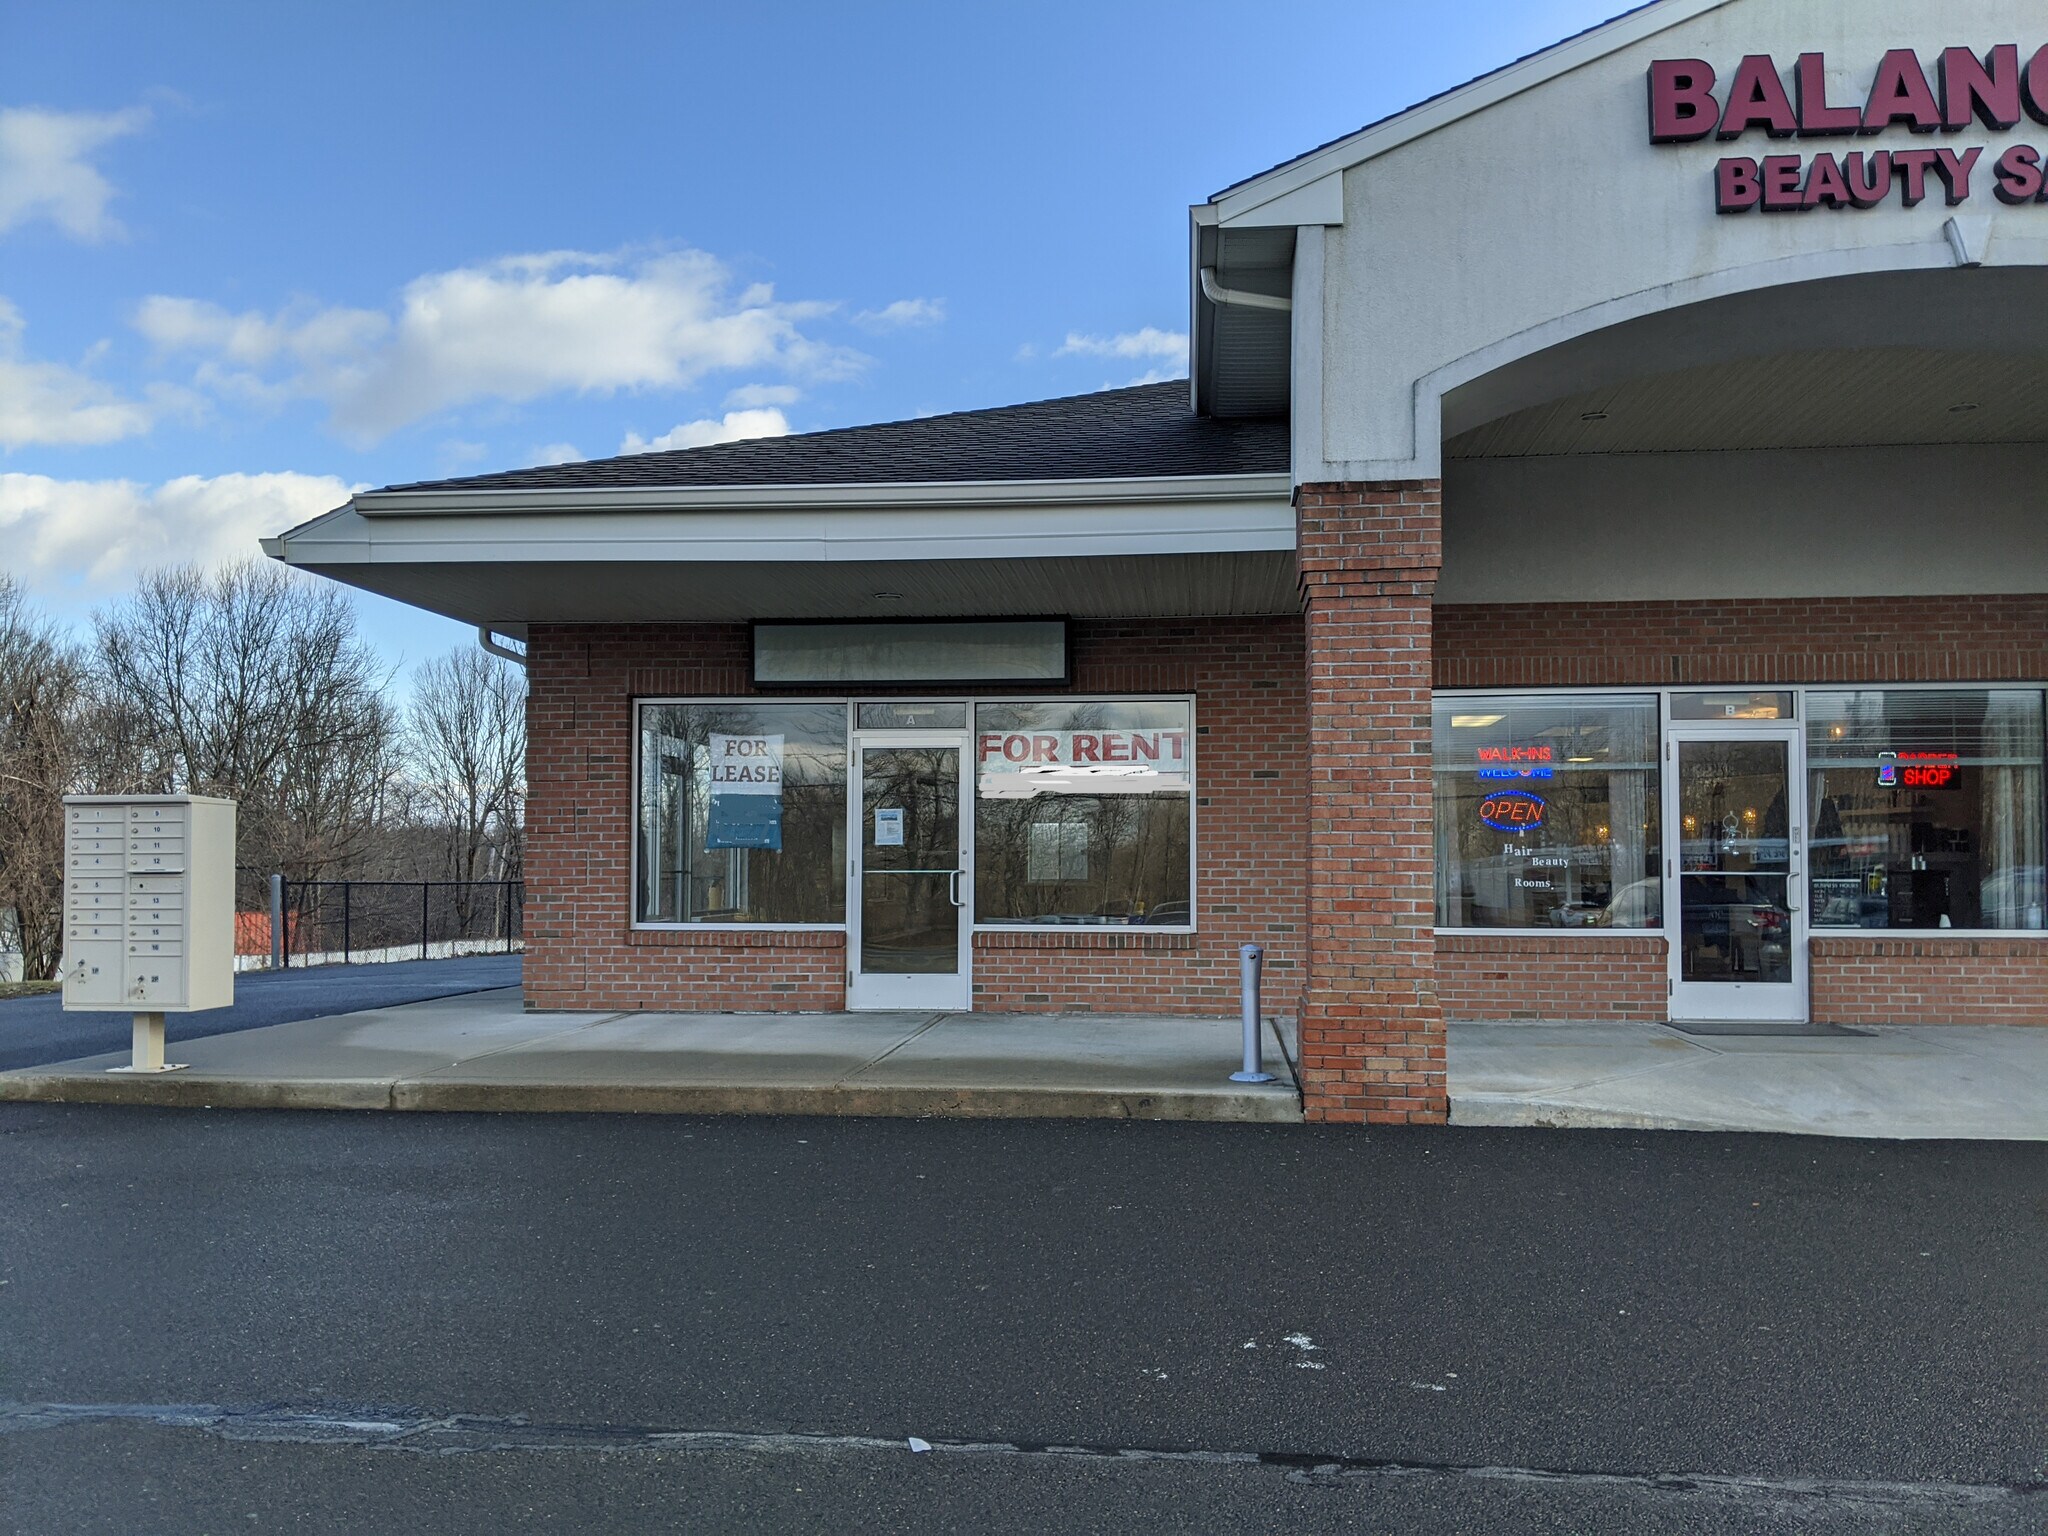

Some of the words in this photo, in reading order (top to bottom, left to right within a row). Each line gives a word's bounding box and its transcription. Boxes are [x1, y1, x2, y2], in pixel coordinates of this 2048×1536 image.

[1647, 43, 2048, 144] BALAN
[1715, 147, 1984, 214] BEAUTY
[1993, 144, 2048, 206] S
[1724, 705, 1735, 716] B
[906, 715, 916, 725] A
[725, 739, 768, 757] FOR
[979, 734, 1060, 762] FOR
[1072, 732, 1187, 762] RENT
[1478, 746, 1552, 761] WALK-INS
[711, 765, 780, 783] LEASE
[1904, 769, 1951, 785] SHOP
[1480, 801, 1544, 820] OPEN
[1504, 844, 1533, 856] Hair
[1532, 857, 1569, 868] Beauty
[1515, 878, 1554, 890] Rooms.
